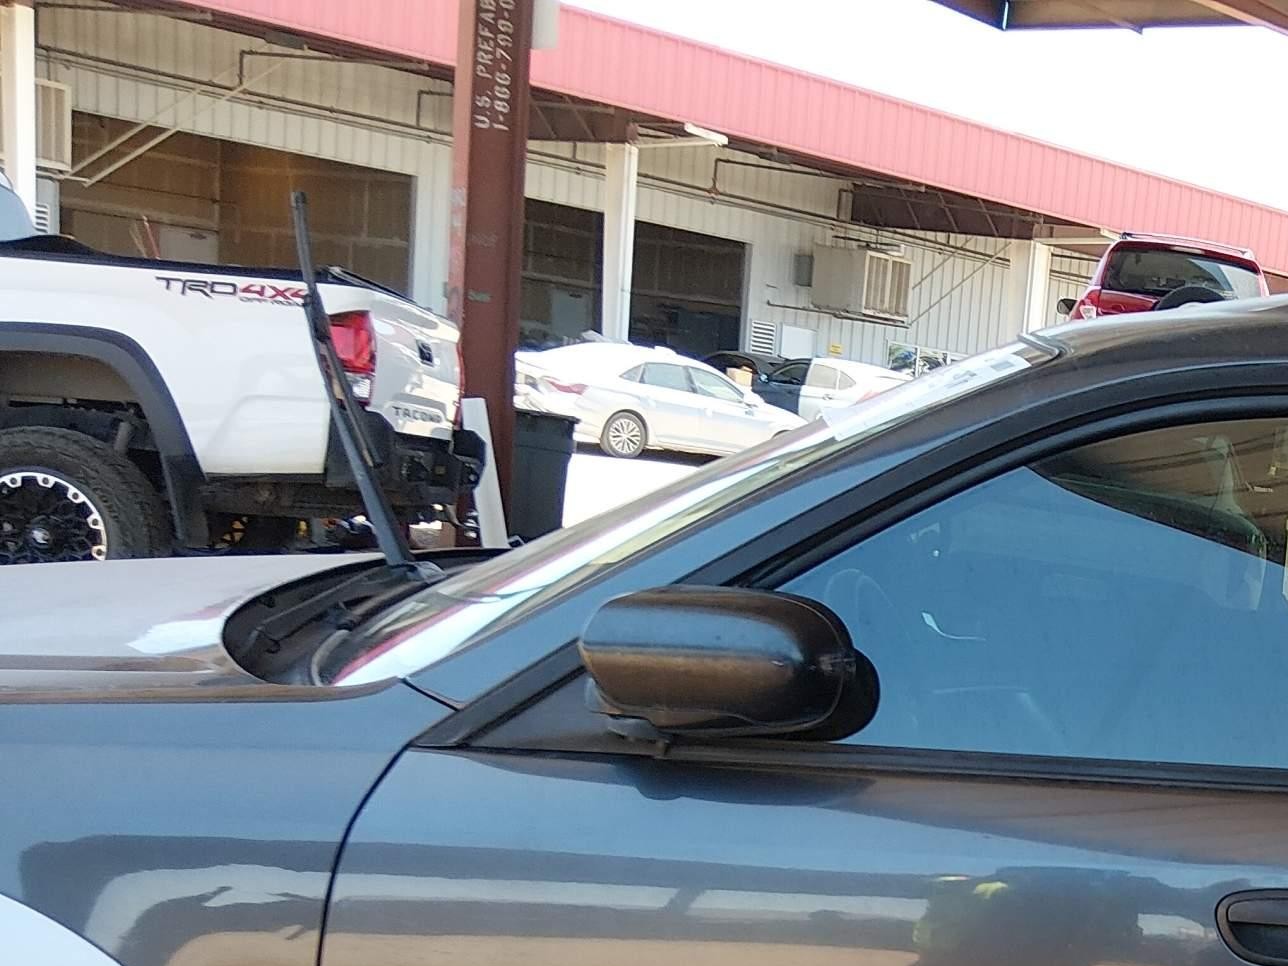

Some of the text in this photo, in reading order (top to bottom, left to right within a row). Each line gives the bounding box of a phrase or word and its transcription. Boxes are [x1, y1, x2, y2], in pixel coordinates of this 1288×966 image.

[473, 0, 496, 128] U.S. PREFAB
[155, 276, 237, 299] TRD
